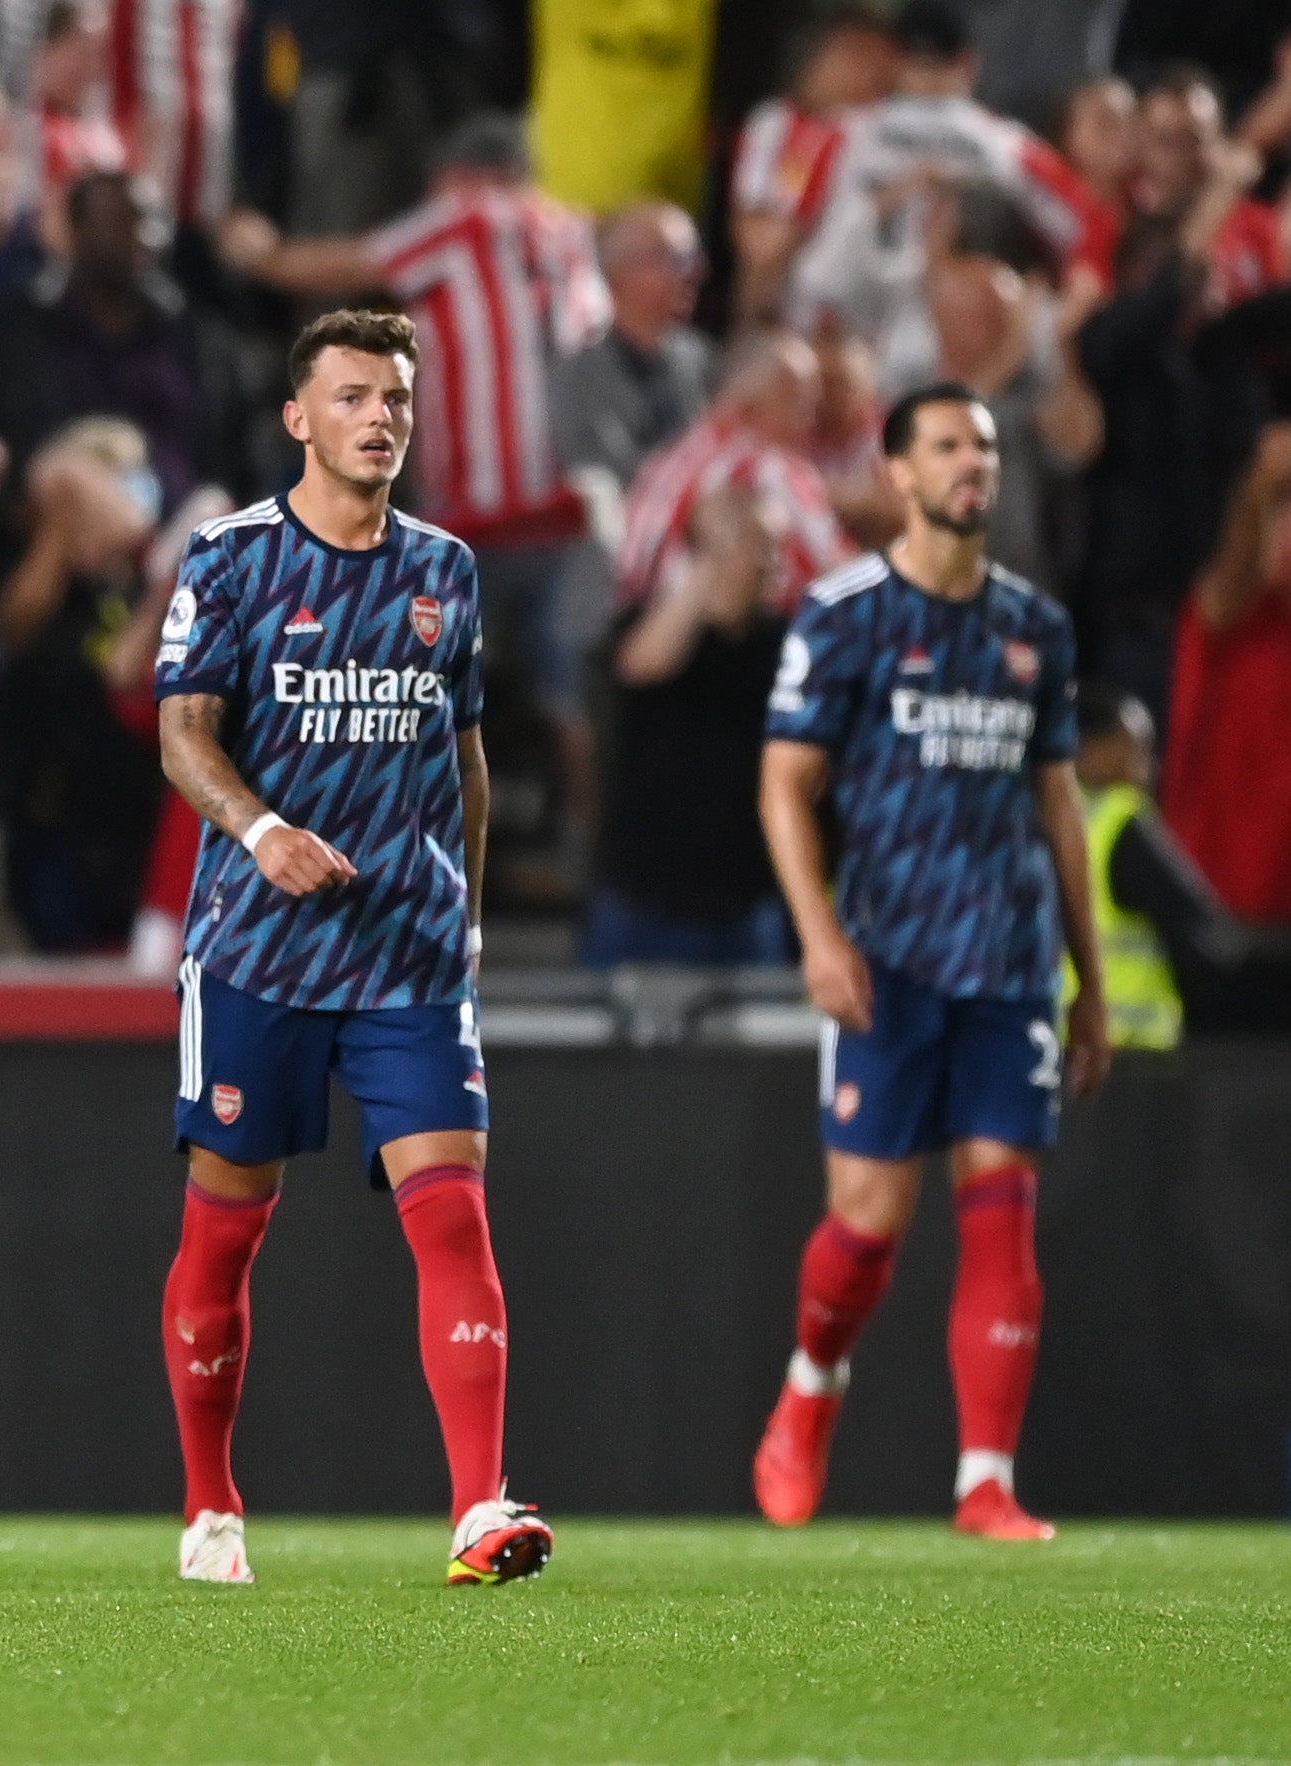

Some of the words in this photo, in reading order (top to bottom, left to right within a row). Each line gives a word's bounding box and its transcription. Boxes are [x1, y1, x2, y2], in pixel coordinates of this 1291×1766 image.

[272, 658, 445, 706] Emirates
[299, 707, 342, 743] FLY
[347, 707, 421, 743] BETTER
